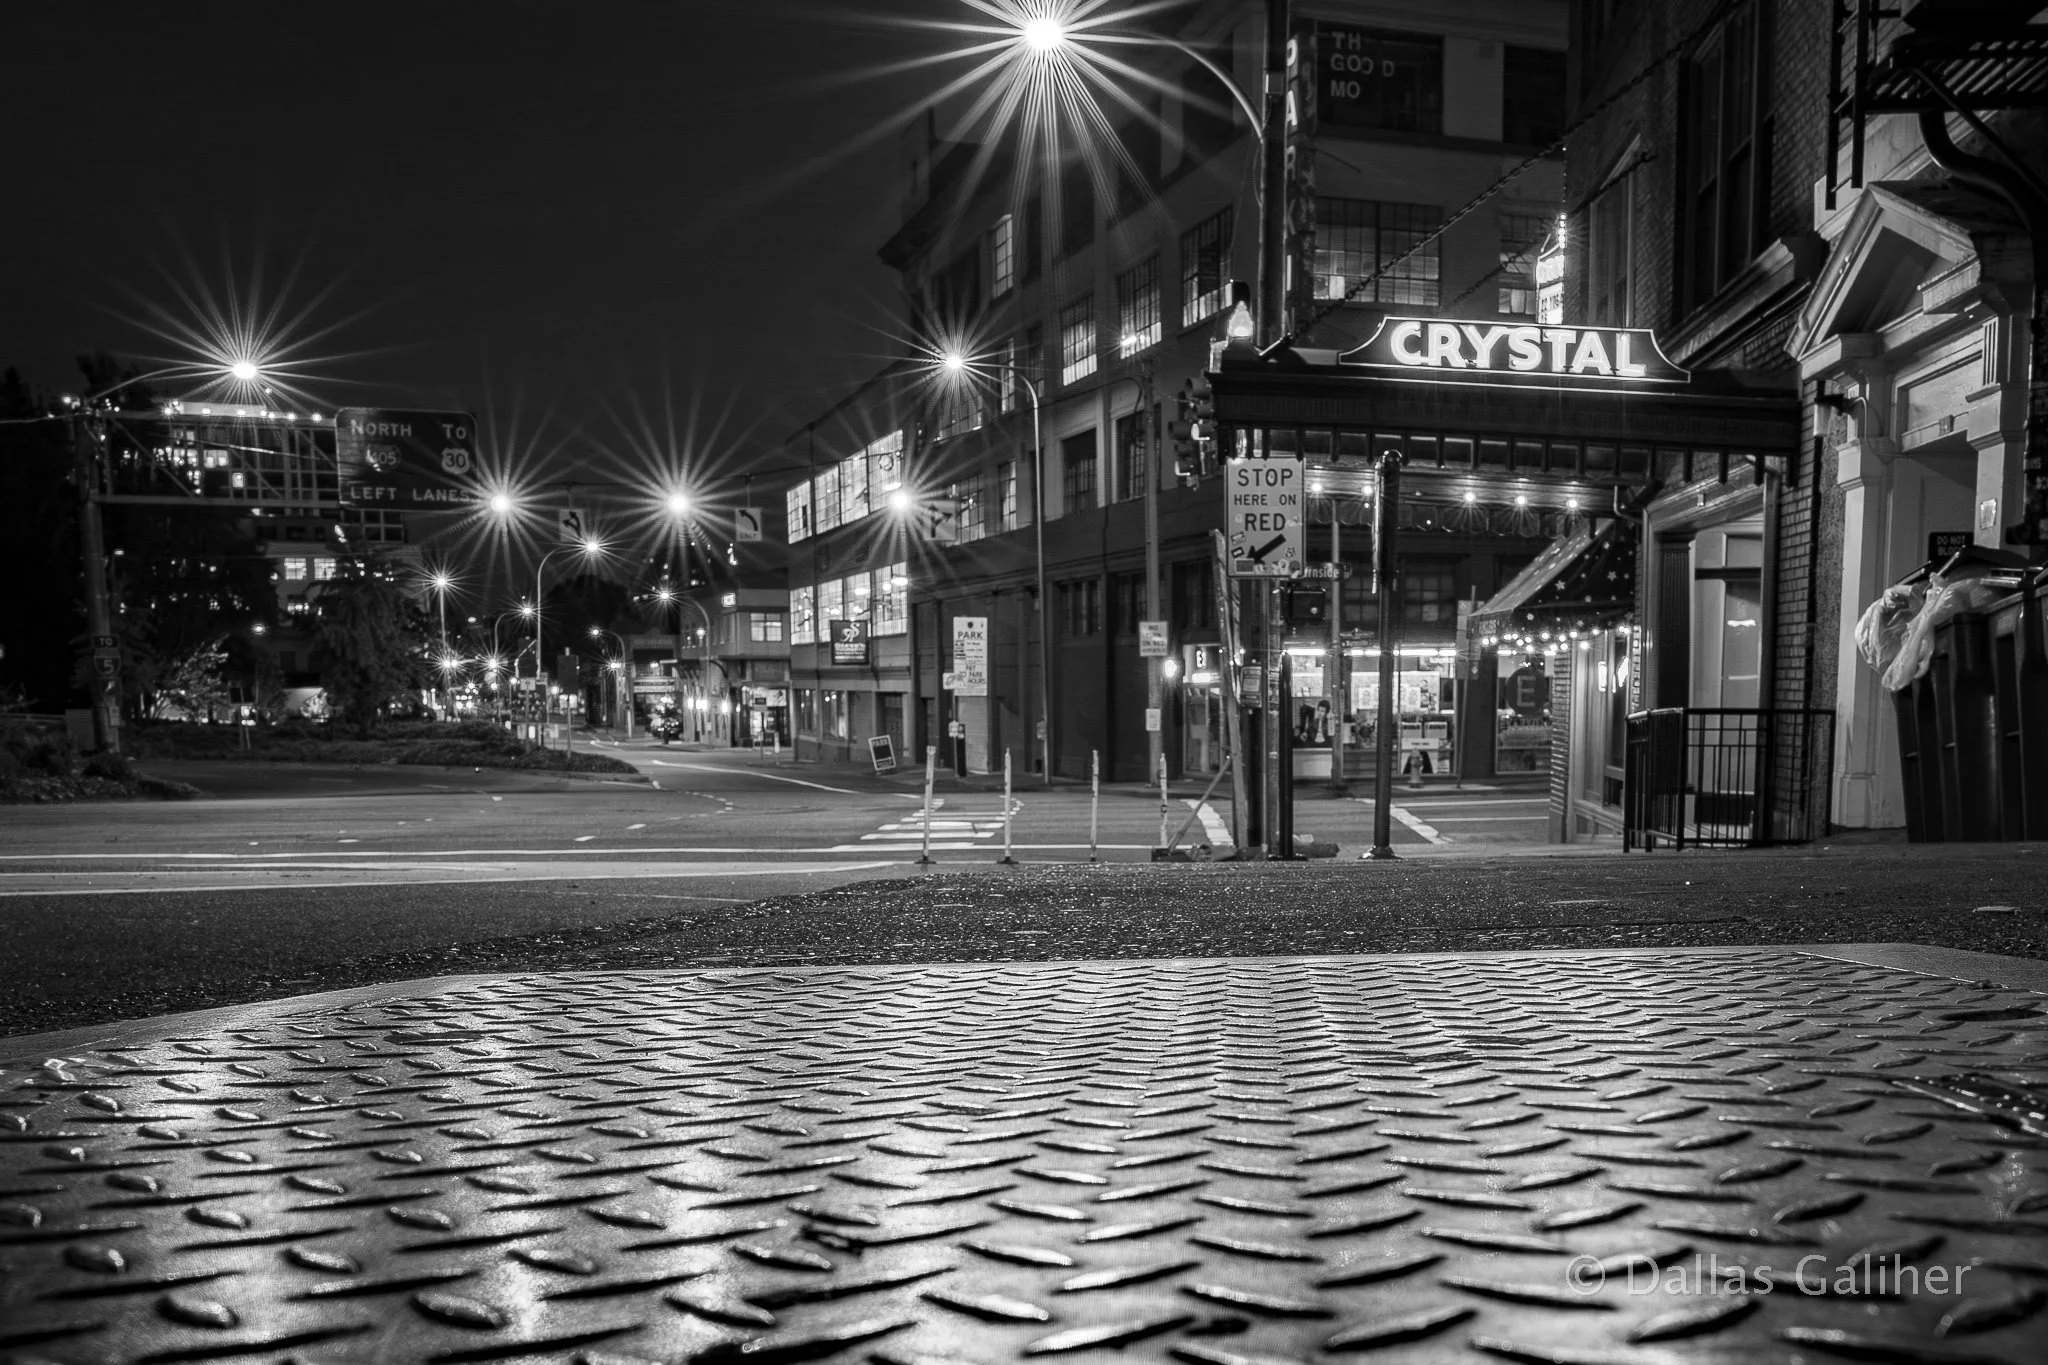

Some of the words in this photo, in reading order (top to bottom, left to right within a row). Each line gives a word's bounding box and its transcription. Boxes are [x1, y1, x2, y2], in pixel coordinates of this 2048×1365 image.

[1331, 31, 1361, 51] TH
[1331, 80, 1361, 99] MO
[1390, 321, 1646, 378] CRYSTAL
[351, 419, 412, 437] NORTH
[445, 452, 466, 469] 30
[1237, 468, 1293, 486] STOP
[350, 486, 396, 500] LEFT
[412, 488, 470, 501] LANES
[1234, 494, 1268, 505] HERE
[1279, 494, 1297, 505] ON
[1244, 513, 1286, 531] RED
[957, 631, 983, 640] PARK
[104, 658, 114, 674] 5
[1517, 675, 1536, 707] E
